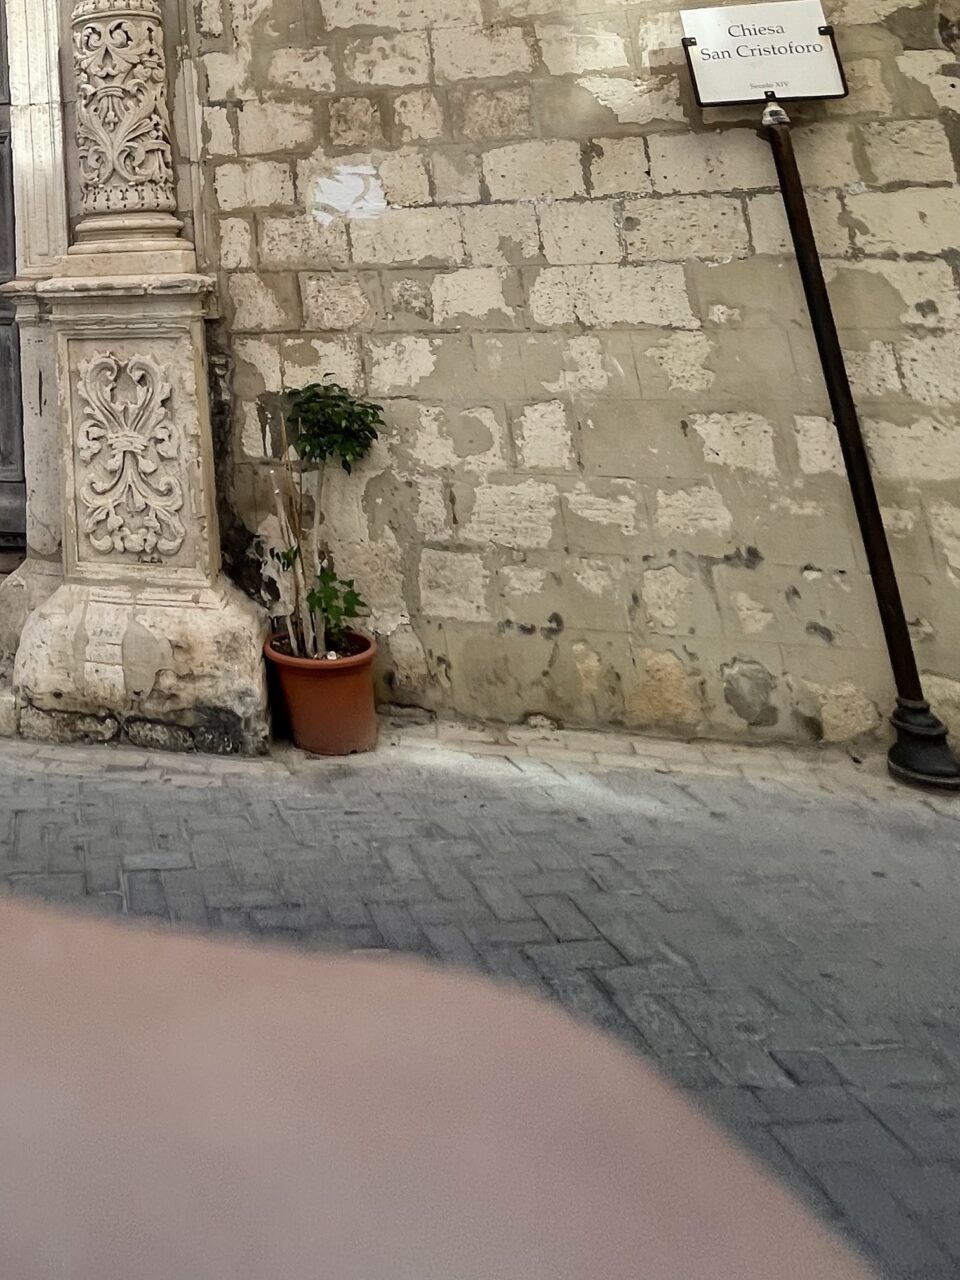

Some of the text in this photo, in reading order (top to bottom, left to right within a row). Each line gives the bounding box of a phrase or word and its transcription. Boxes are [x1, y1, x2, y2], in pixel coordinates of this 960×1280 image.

[727, 23, 786, 39] Chiesa
[700, 41, 824, 61] San Cristoforo
